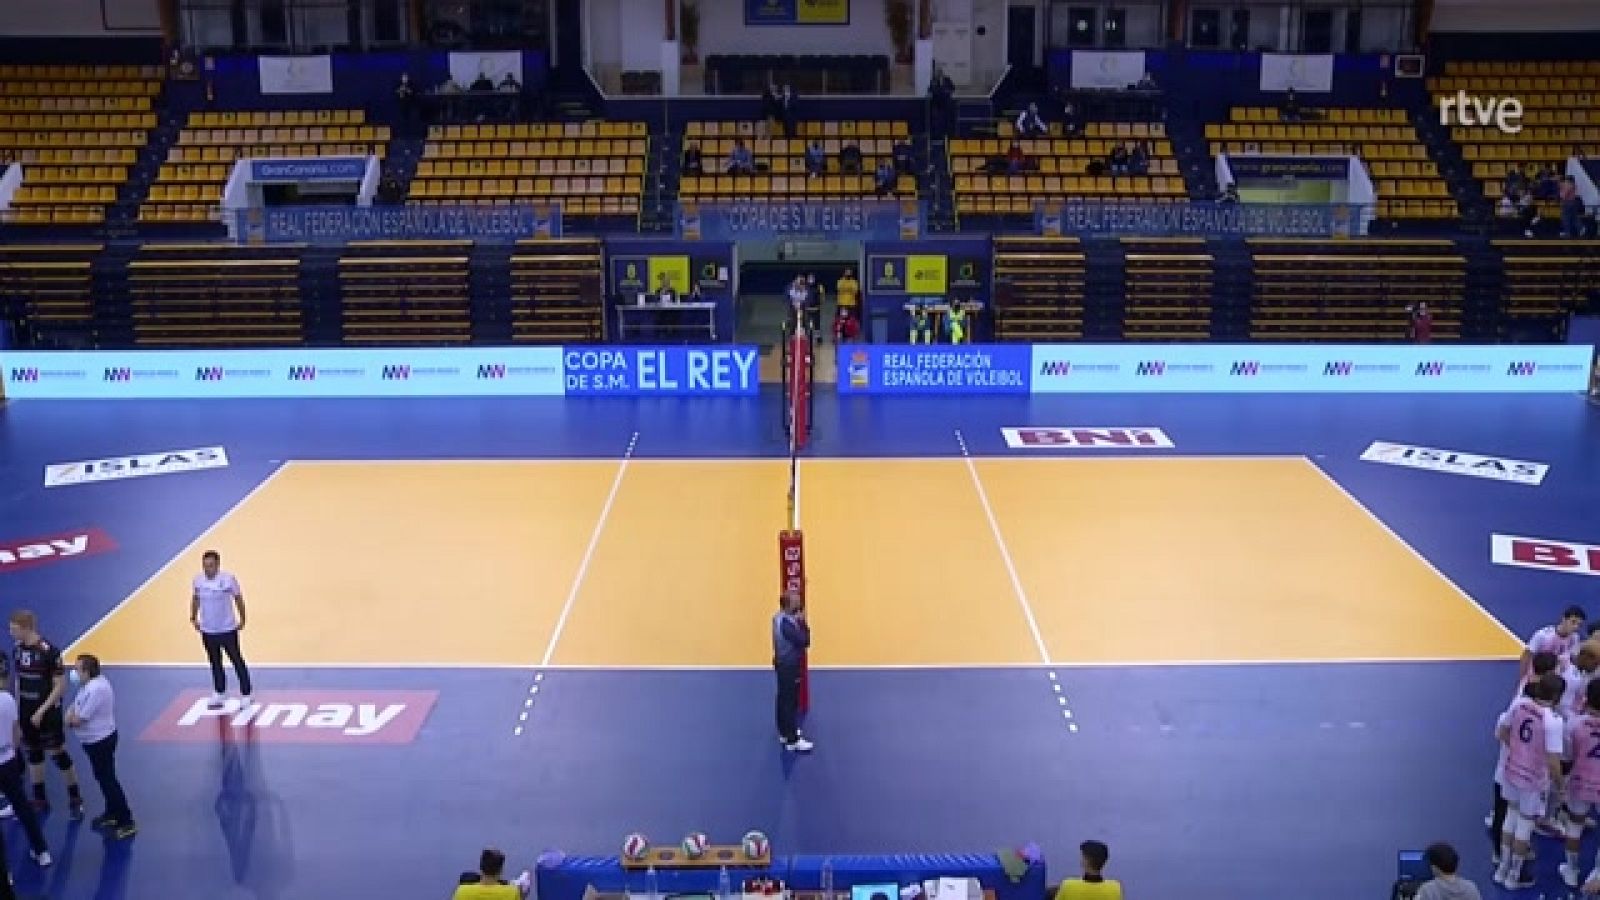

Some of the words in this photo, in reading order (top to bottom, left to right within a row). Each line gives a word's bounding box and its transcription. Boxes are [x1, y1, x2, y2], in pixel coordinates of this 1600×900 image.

[729, 206, 767, 230] COPA
[769, 206, 788, 230] DE
[823, 206, 841, 230] EL
[565, 352, 627, 371] COPA
[638, 350, 678, 390] EL
[689, 350, 757, 390] REY
[884, 353, 913, 369] REAL
[917, 350, 992, 369] FEDERACIÓN
[567, 375, 589, 391] DE
[592, 375, 630, 391] S.M.
[947, 370, 964, 386] DE
[966, 370, 1023, 386] VOLEIBOL
[84, 448, 220, 475] ISLAS
[1402, 448, 1537, 477] ISLAS
[177, 698, 406, 736] Pinay
[1519, 718, 1533, 744] 6
